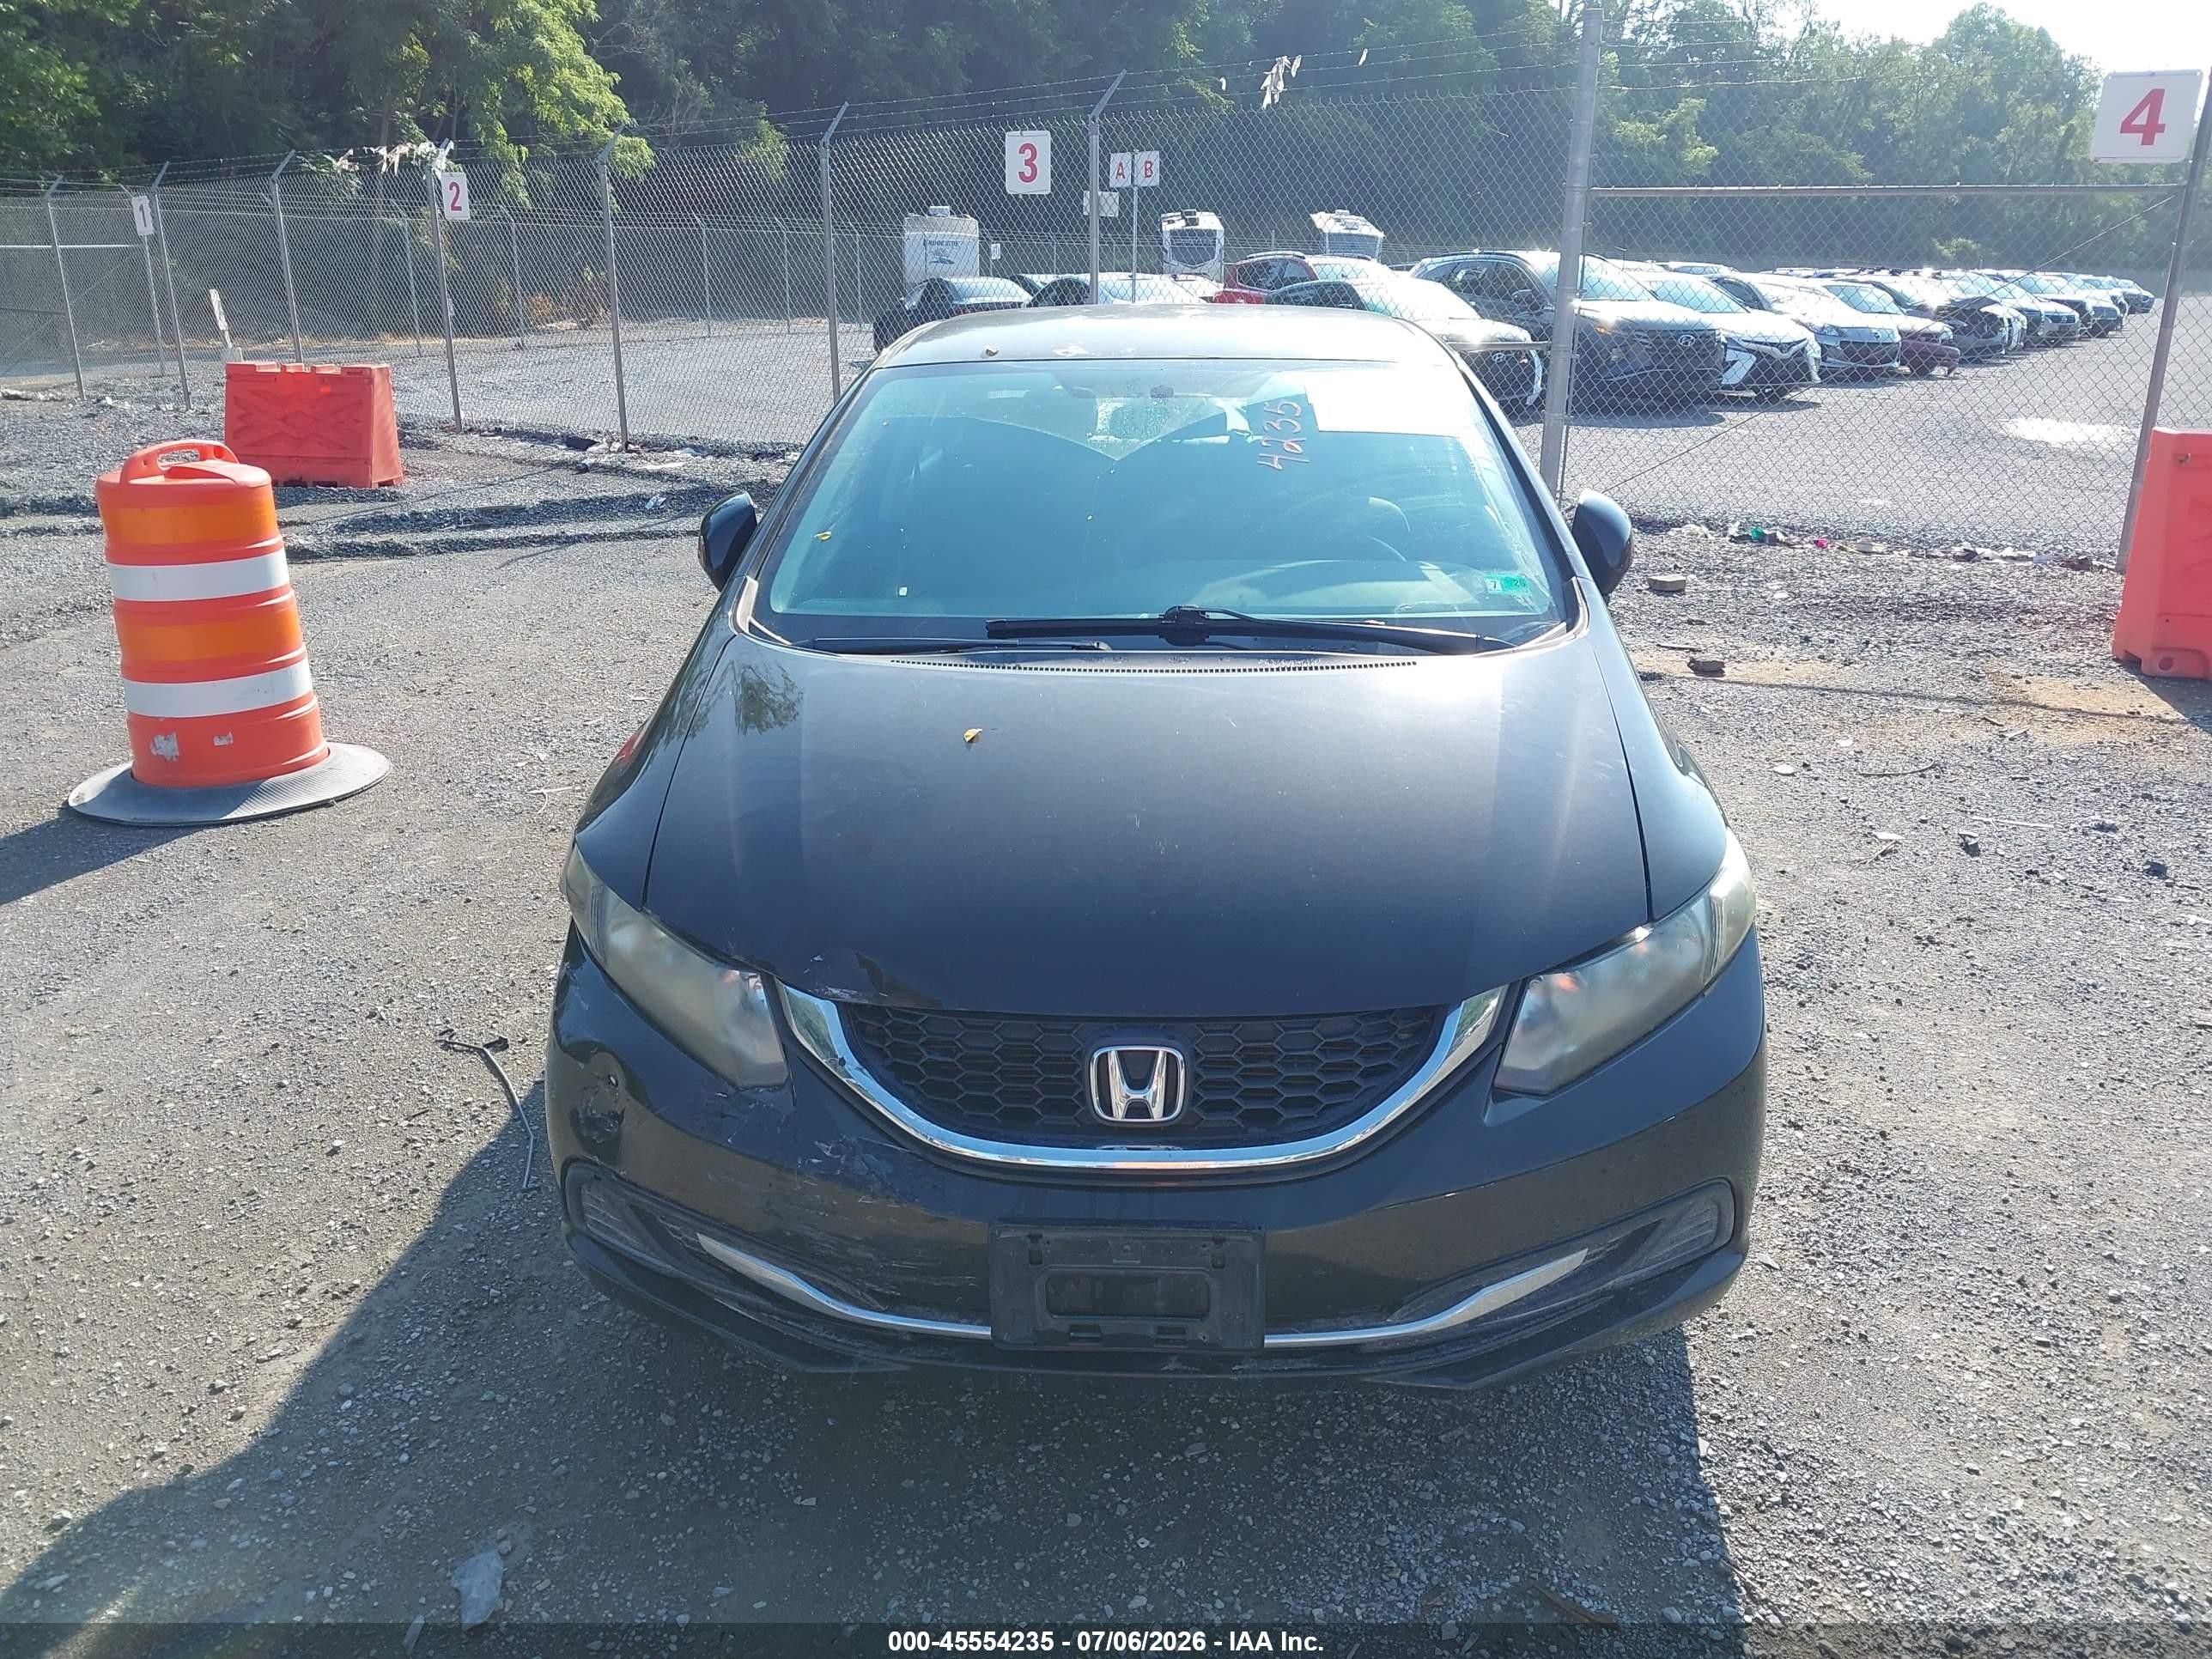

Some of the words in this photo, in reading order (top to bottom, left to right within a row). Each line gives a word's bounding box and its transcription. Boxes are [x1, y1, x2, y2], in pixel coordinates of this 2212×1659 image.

[2119, 88, 2166, 146] 4
[1018, 143, 1038, 184] 3
[1115, 161, 1126, 179] A
[1144, 160, 1154, 179] B
[448, 181, 462, 211] 2
[138, 204, 147, 228] 1
[1256, 401, 1310, 471] 4235
[1490, 580, 1498, 590] 7
